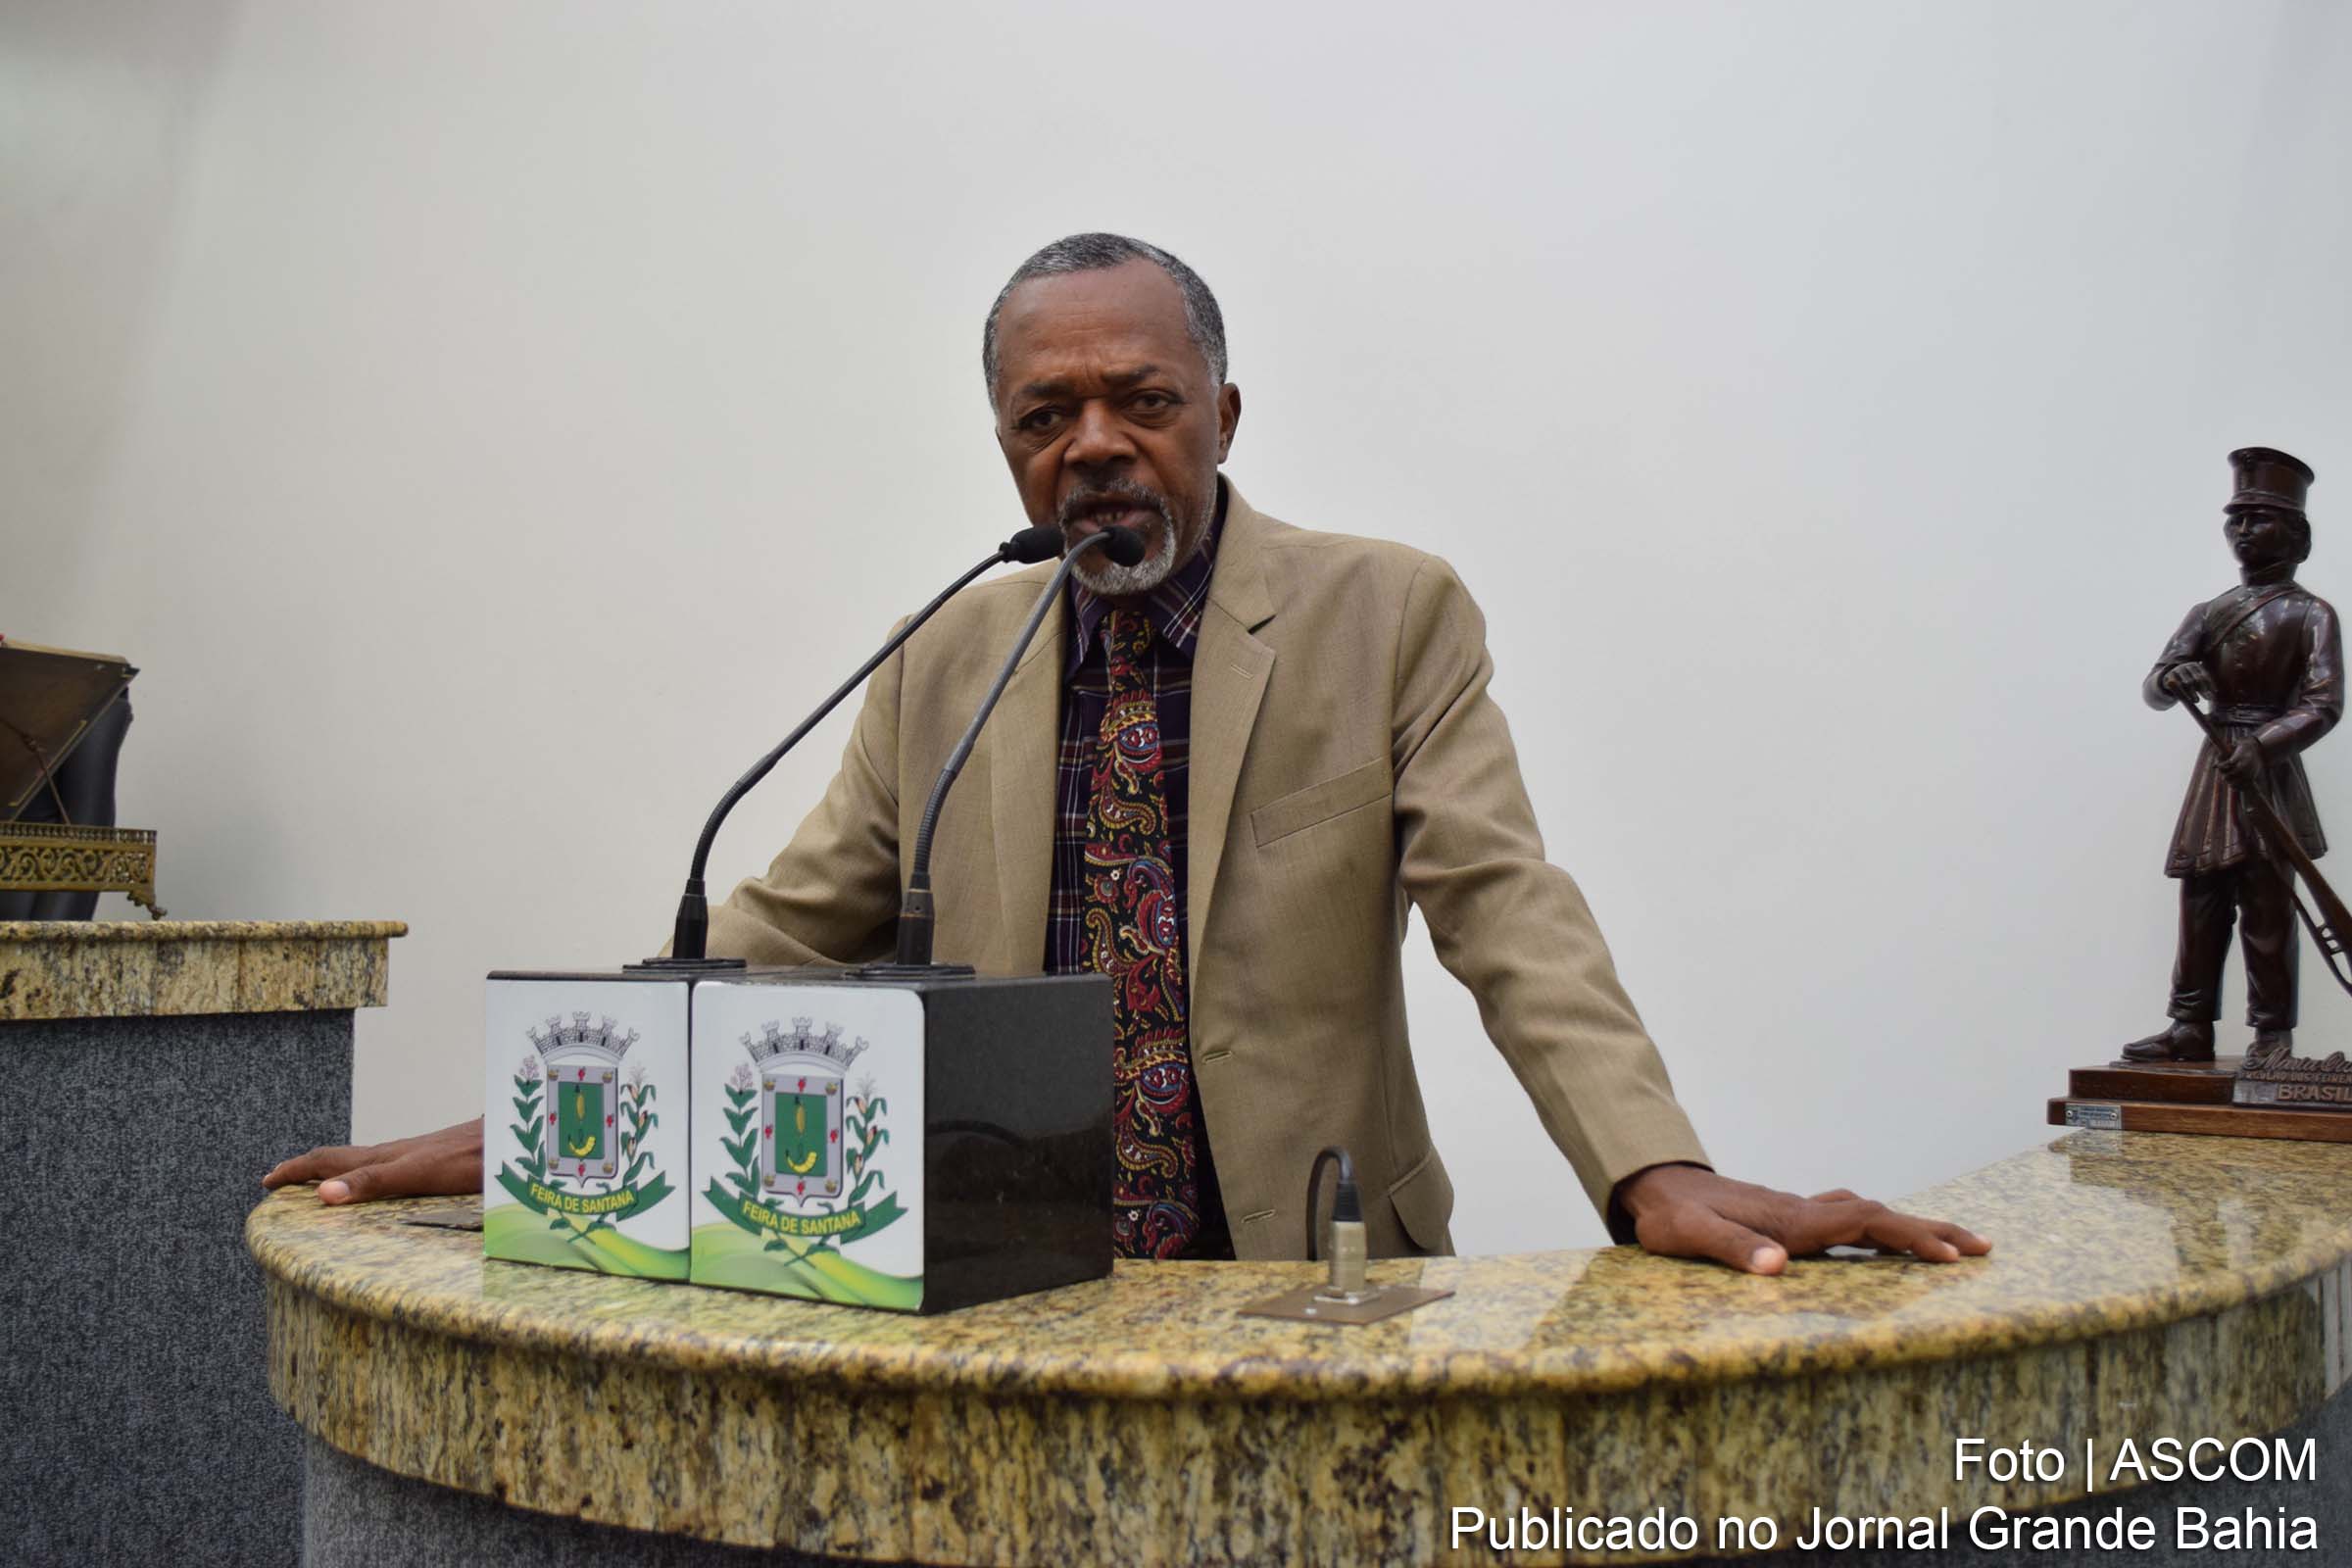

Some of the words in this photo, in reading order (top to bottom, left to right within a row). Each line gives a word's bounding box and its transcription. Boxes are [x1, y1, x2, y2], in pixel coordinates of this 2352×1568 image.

[2278, 1084, 2352, 1102] BRASIL
[531, 1183, 563, 1208] FEIRA
[564, 1197, 580, 1212] DE
[582, 1190, 634, 1213] SANTANA
[743, 1200, 778, 1228] FEIRA
[780, 1216, 798, 1232] DE
[801, 1210, 860, 1235] SANTANA
